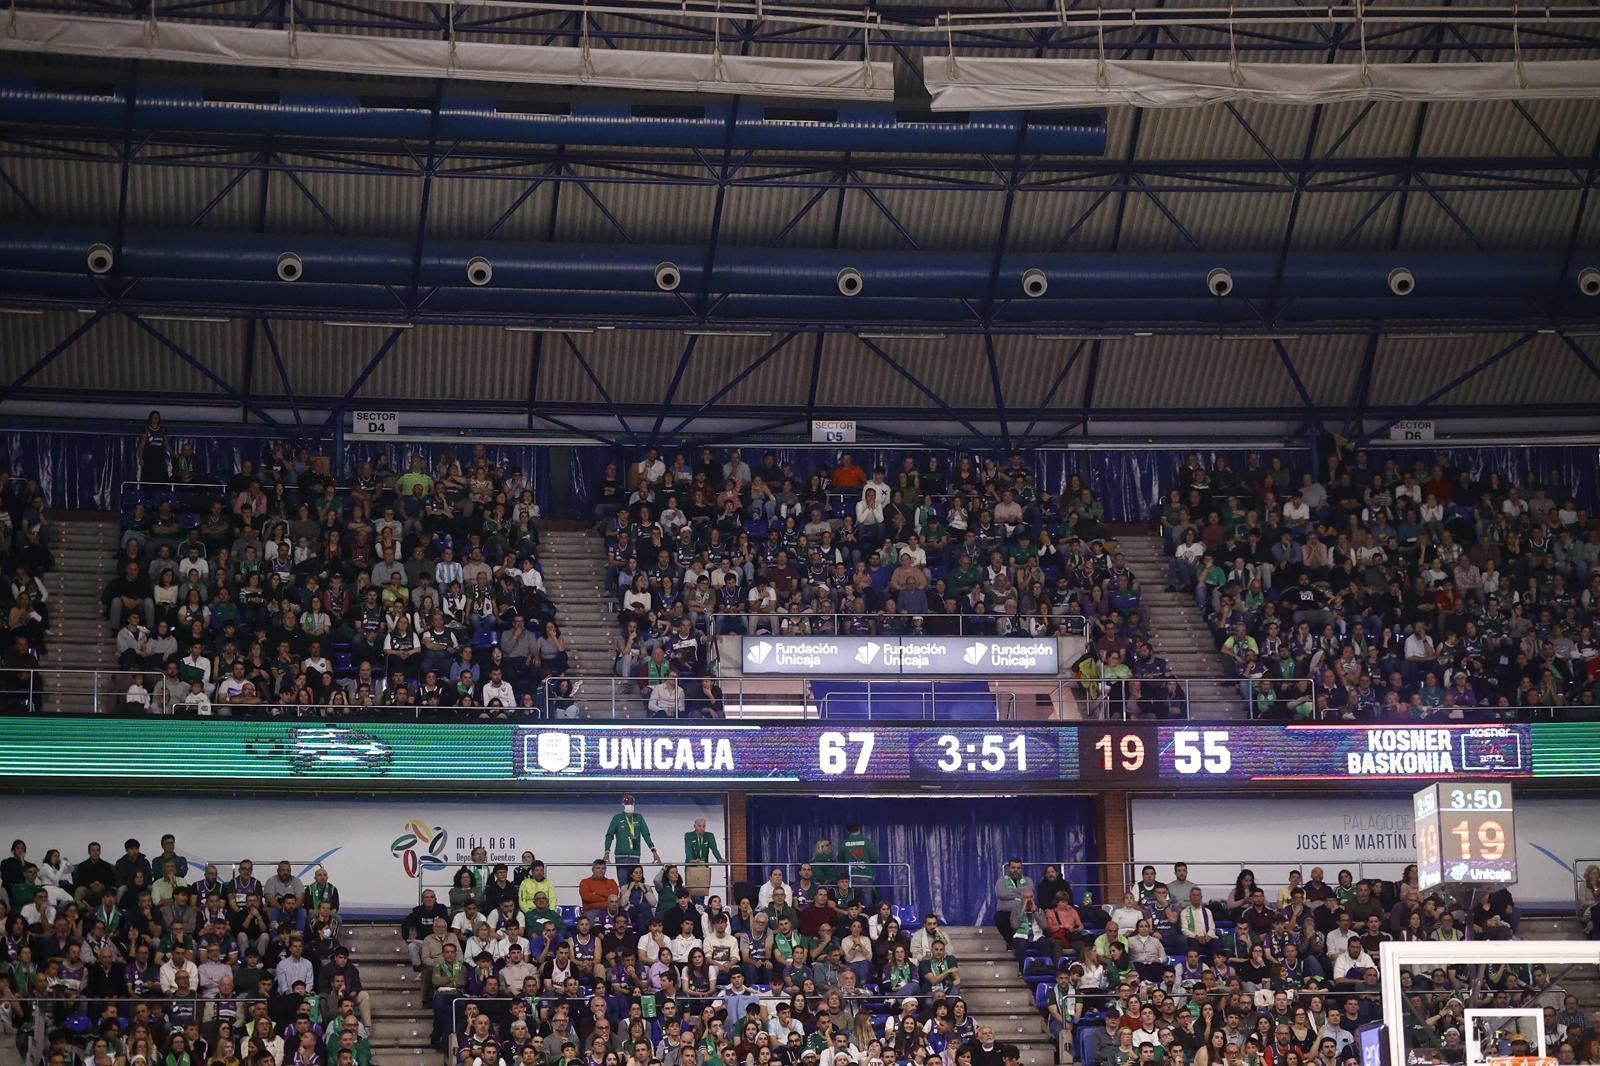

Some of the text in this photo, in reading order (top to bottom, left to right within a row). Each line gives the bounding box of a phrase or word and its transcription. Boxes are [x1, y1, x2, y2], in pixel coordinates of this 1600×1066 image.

[356, 412, 396, 421] SECTOR
[368, 422, 385, 433] D4
[815, 421, 854, 430] SECTOR
[1393, 421, 1432, 430] SECTOR
[826, 431, 843, 442] D5
[1405, 431, 1422, 440] D6
[775, 642, 838, 654] Fundación
[883, 643, 946, 655] Fundación
[991, 643, 1053, 655] Fundación
[775, 654, 821, 668] Unicaja
[883, 655, 929, 669] Unicaja
[991, 655, 1036, 669] Unicaja
[1367, 729, 1452, 751] KOSNER
[598, 738, 735, 770] UNICAJA
[819, 731, 875, 774] 67
[937, 734, 1027, 772] 3:51
[1095, 734, 1145, 771] 19
[1174, 731, 1232, 774] 55
[1347, 751, 1454, 774] BASKONIA
[1450, 789, 1502, 809] 3:50
[1343, 814, 1412, 831] PALACIO DE
[1296, 832, 1328, 850] JOSÉ
[1355, 831, 1407, 850] MARTÍN
[1452, 820, 1505, 860] 19
[1470, 868, 1512, 883] Unicaja
